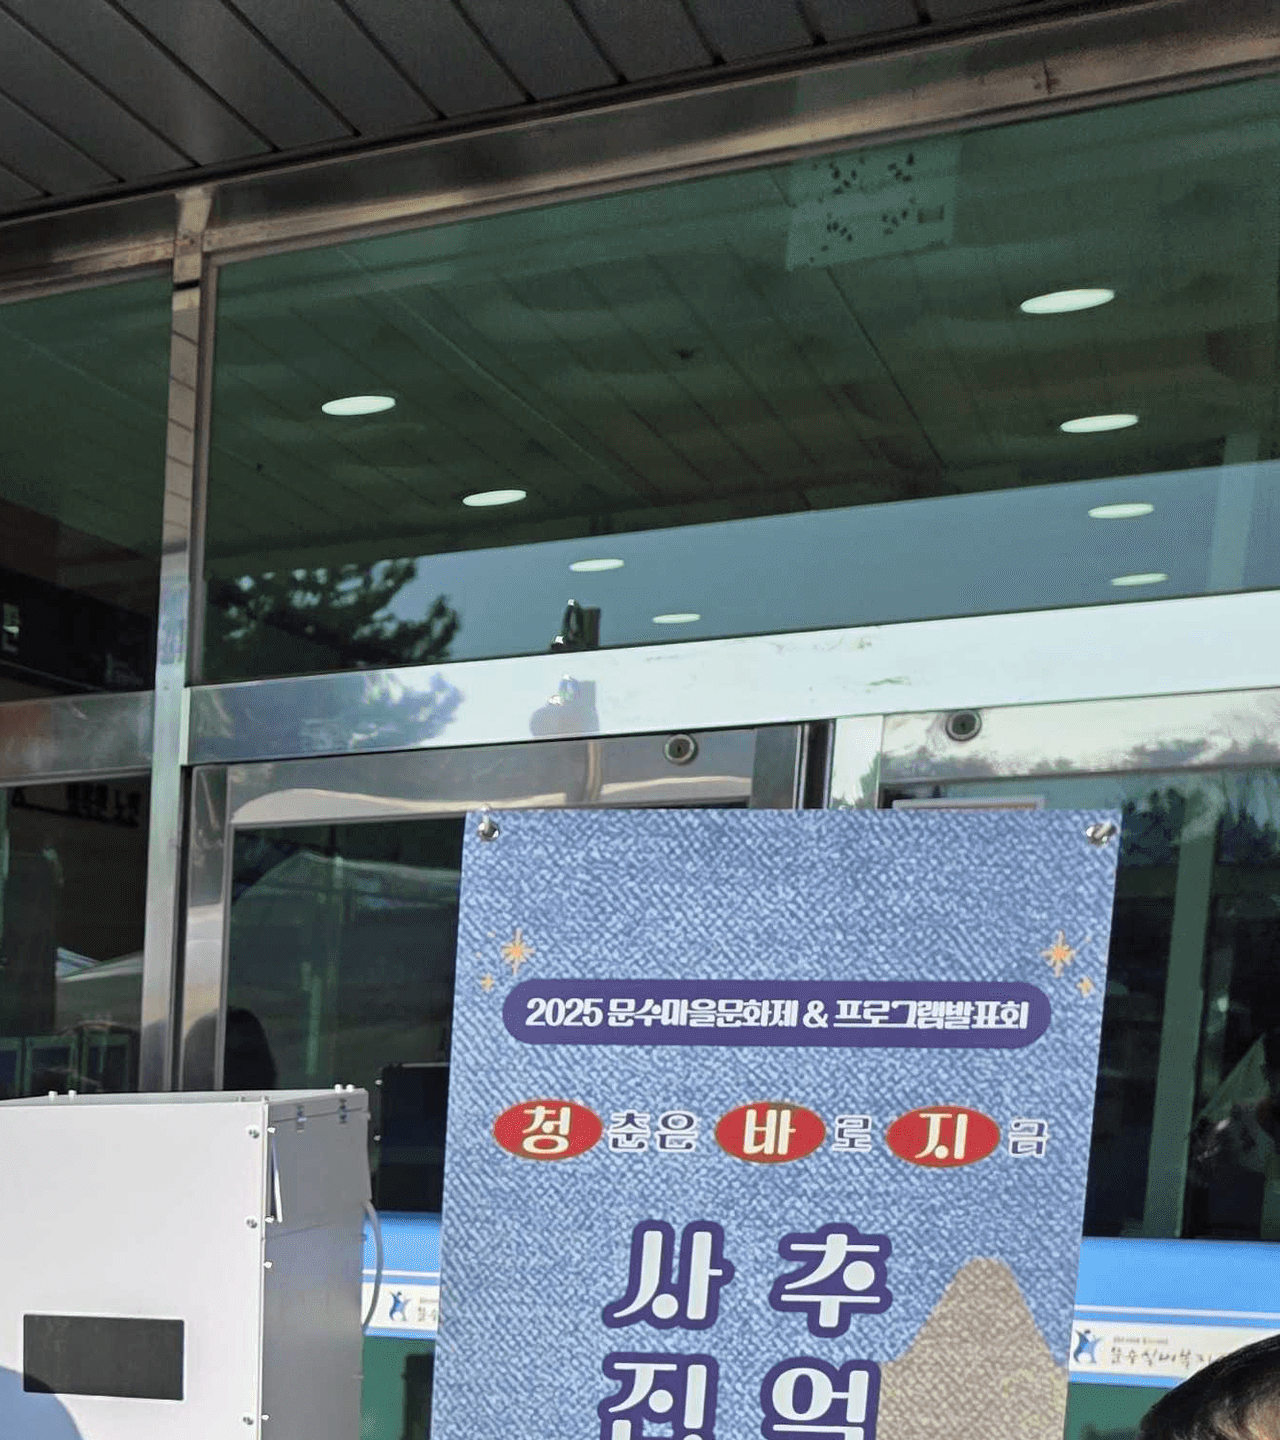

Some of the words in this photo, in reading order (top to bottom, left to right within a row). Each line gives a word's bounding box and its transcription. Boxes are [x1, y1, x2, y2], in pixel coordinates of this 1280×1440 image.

[524, 997, 604, 1028] 2025
[607, 998, 799, 1028] 문수마을문화제
[802, 999, 829, 1029] &
[833, 999, 1030, 1030] 프로그램발표회
